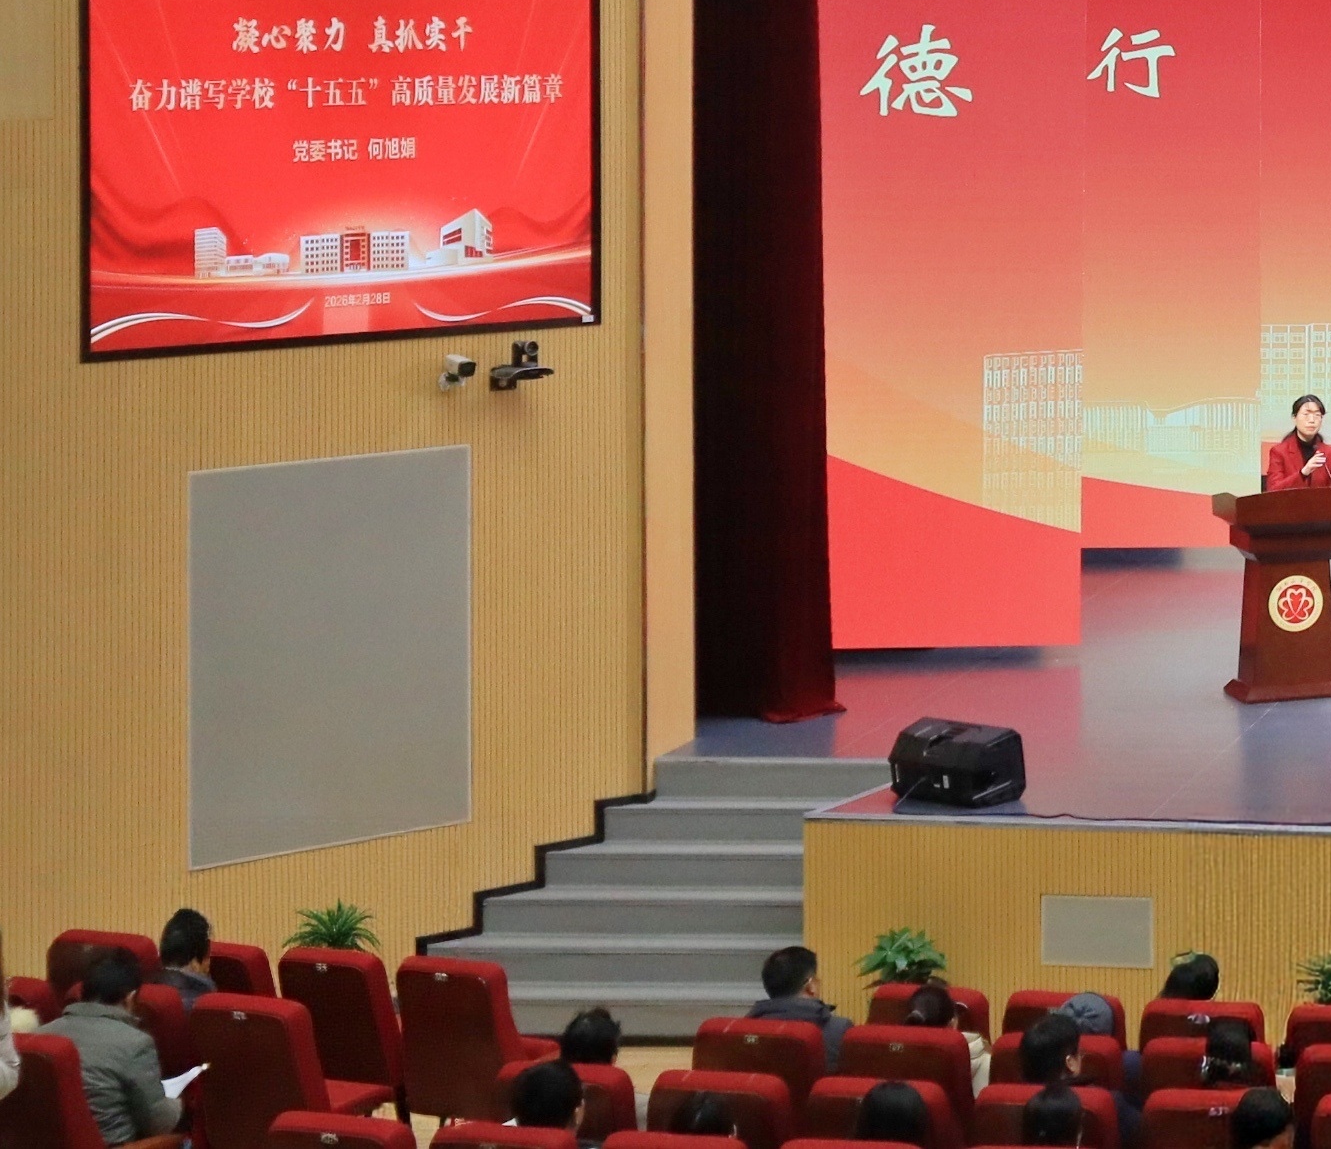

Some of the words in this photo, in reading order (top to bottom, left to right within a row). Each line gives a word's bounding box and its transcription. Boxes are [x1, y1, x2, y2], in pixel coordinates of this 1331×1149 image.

[232, 16, 346, 54] 凝心聚力
[367, 15, 474, 53] 真抓实干
[292, 138, 359, 162] 党委书记
[367, 137, 417, 160] 何旭娟
[324, 292, 391, 308] 2026年2月28日
